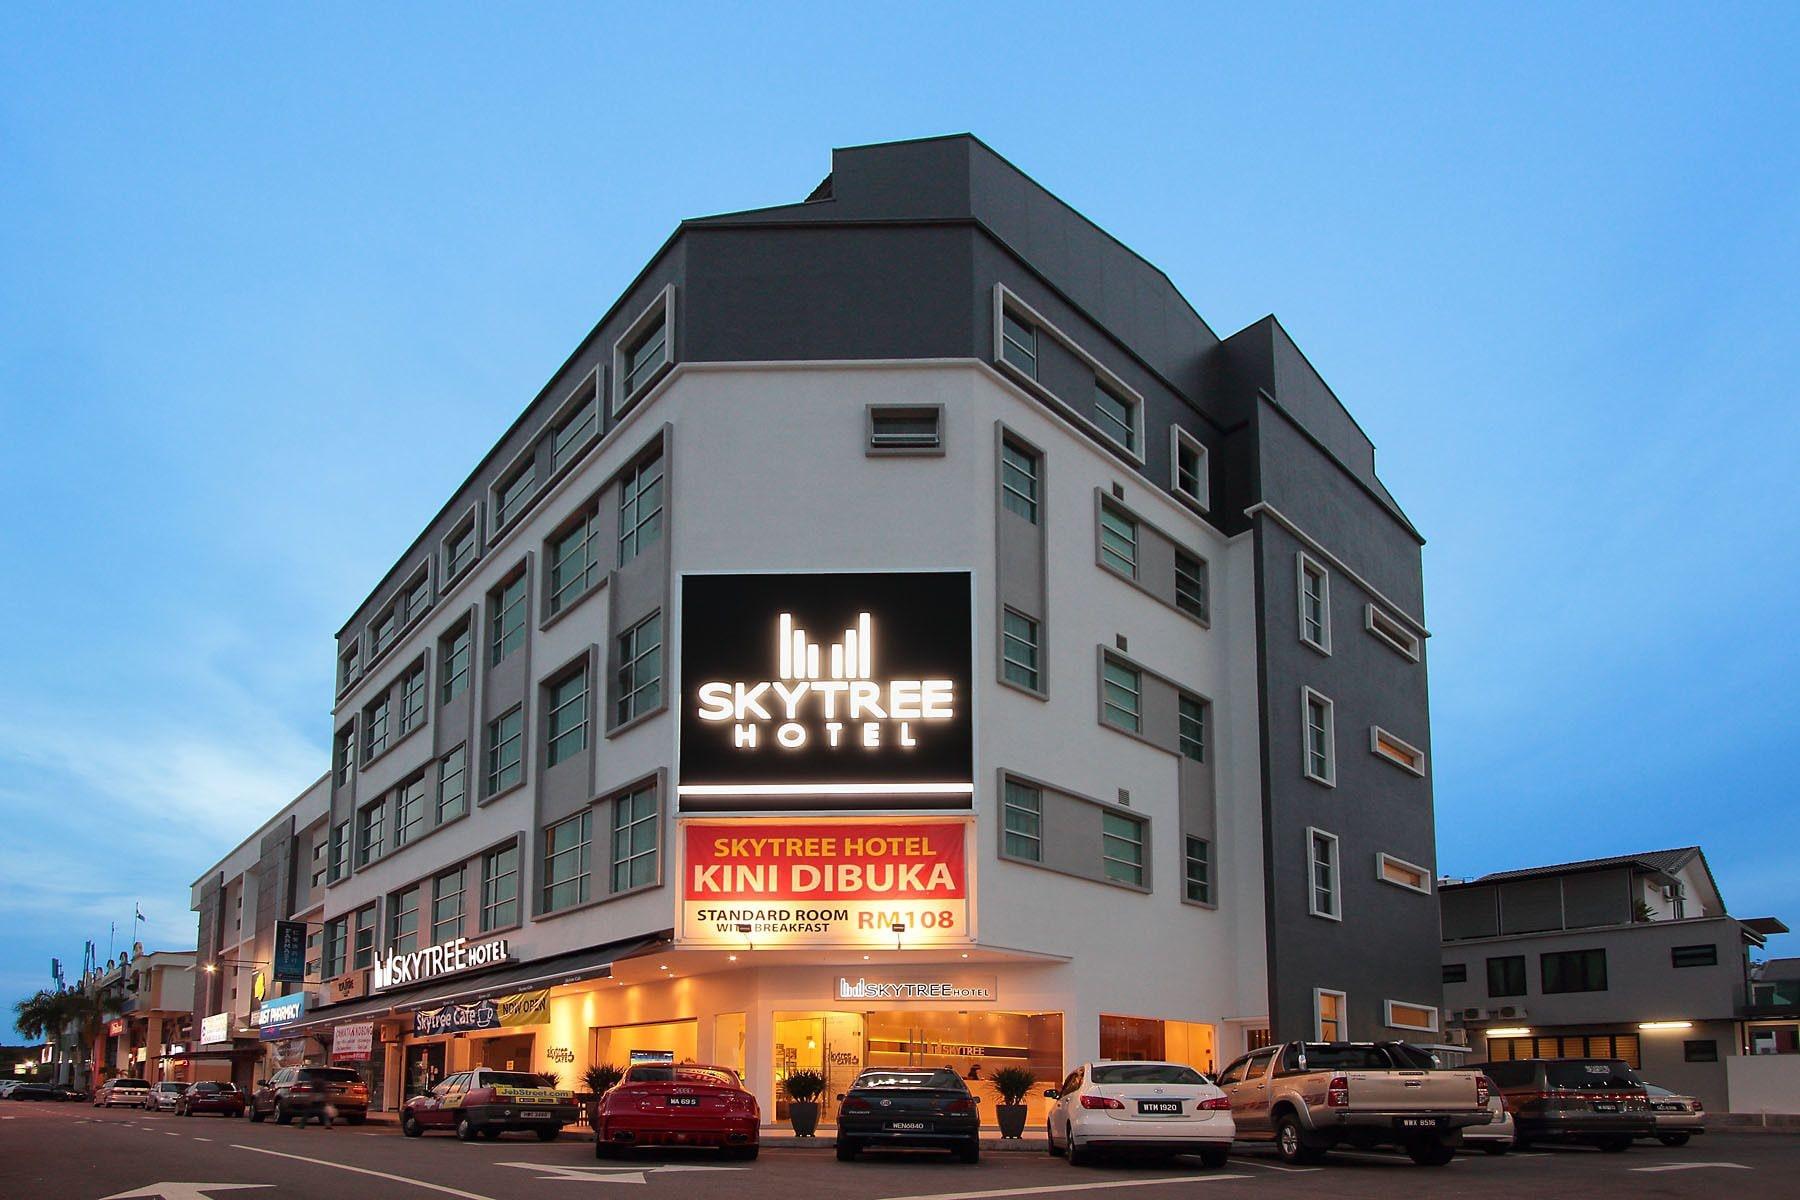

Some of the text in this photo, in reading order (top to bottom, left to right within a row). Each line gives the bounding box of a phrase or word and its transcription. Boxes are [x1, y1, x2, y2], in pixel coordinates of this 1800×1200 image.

[698, 680, 953, 720] SKYTREE
[734, 722, 916, 748] HOTEL
[714, 837, 936, 857] SKYTREE HOTEL
[694, 862, 957, 893] KINI DIBUKA
[698, 909, 954, 930] STANDARD ROOM RM108
[716, 923, 829, 933] WIT BREAKFAST
[392, 937, 507, 985] SKYTREE HOTEL
[865, 983, 989, 997] SKYTREE HOTEL
[503, 997, 546, 1015] NOW OPEN
[416, 1010, 452, 1034] Skytree
[942, 1045, 985, 1056] SKYTREE
[501, 1088, 569, 1098] JobStreet.com
